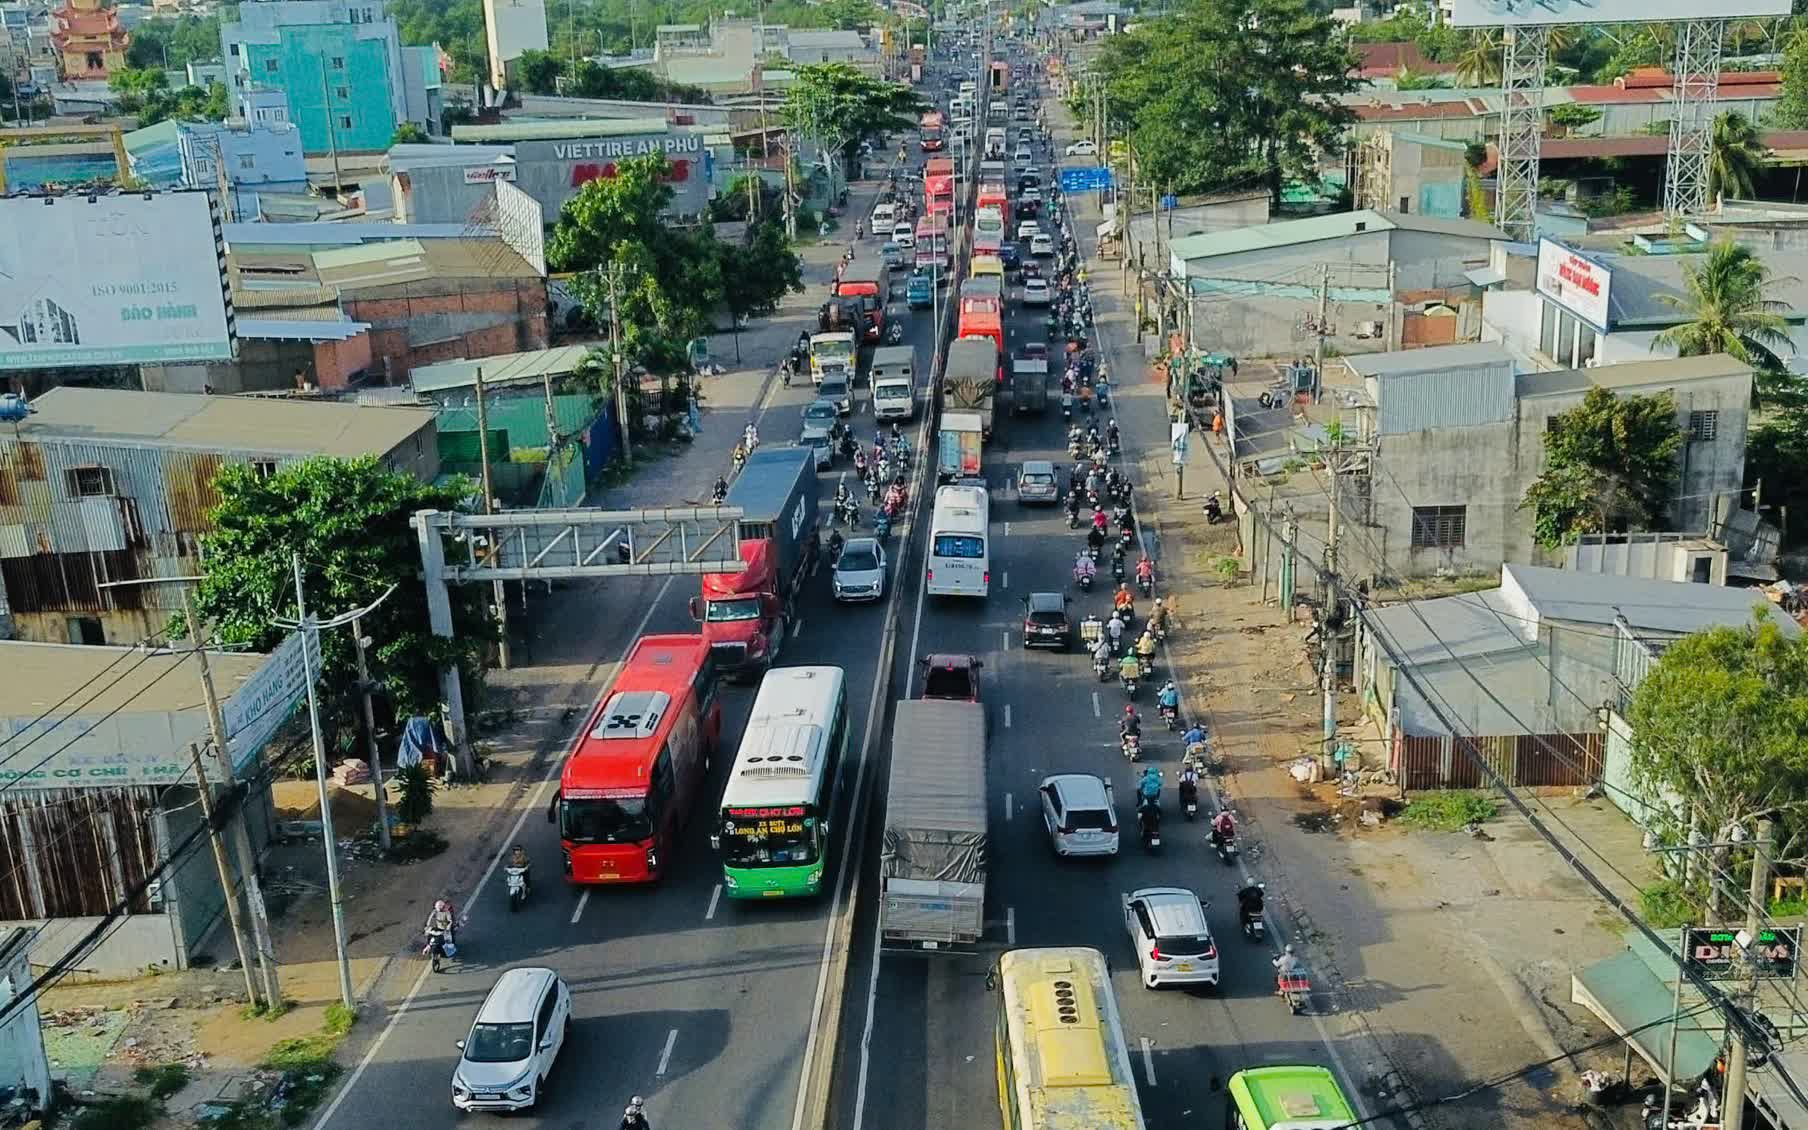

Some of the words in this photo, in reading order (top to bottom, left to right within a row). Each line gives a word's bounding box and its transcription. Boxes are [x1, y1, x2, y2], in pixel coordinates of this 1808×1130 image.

[553, 140, 632, 159] VIETTIRE
[636, 139, 661, 153] AN
[664, 134, 699, 153] PHÚ
[91, 284, 116, 297] ISO
[245, 697, 262, 723] KHO
[735, 827, 755, 836] LONG
[756, 826, 768, 835] AN
